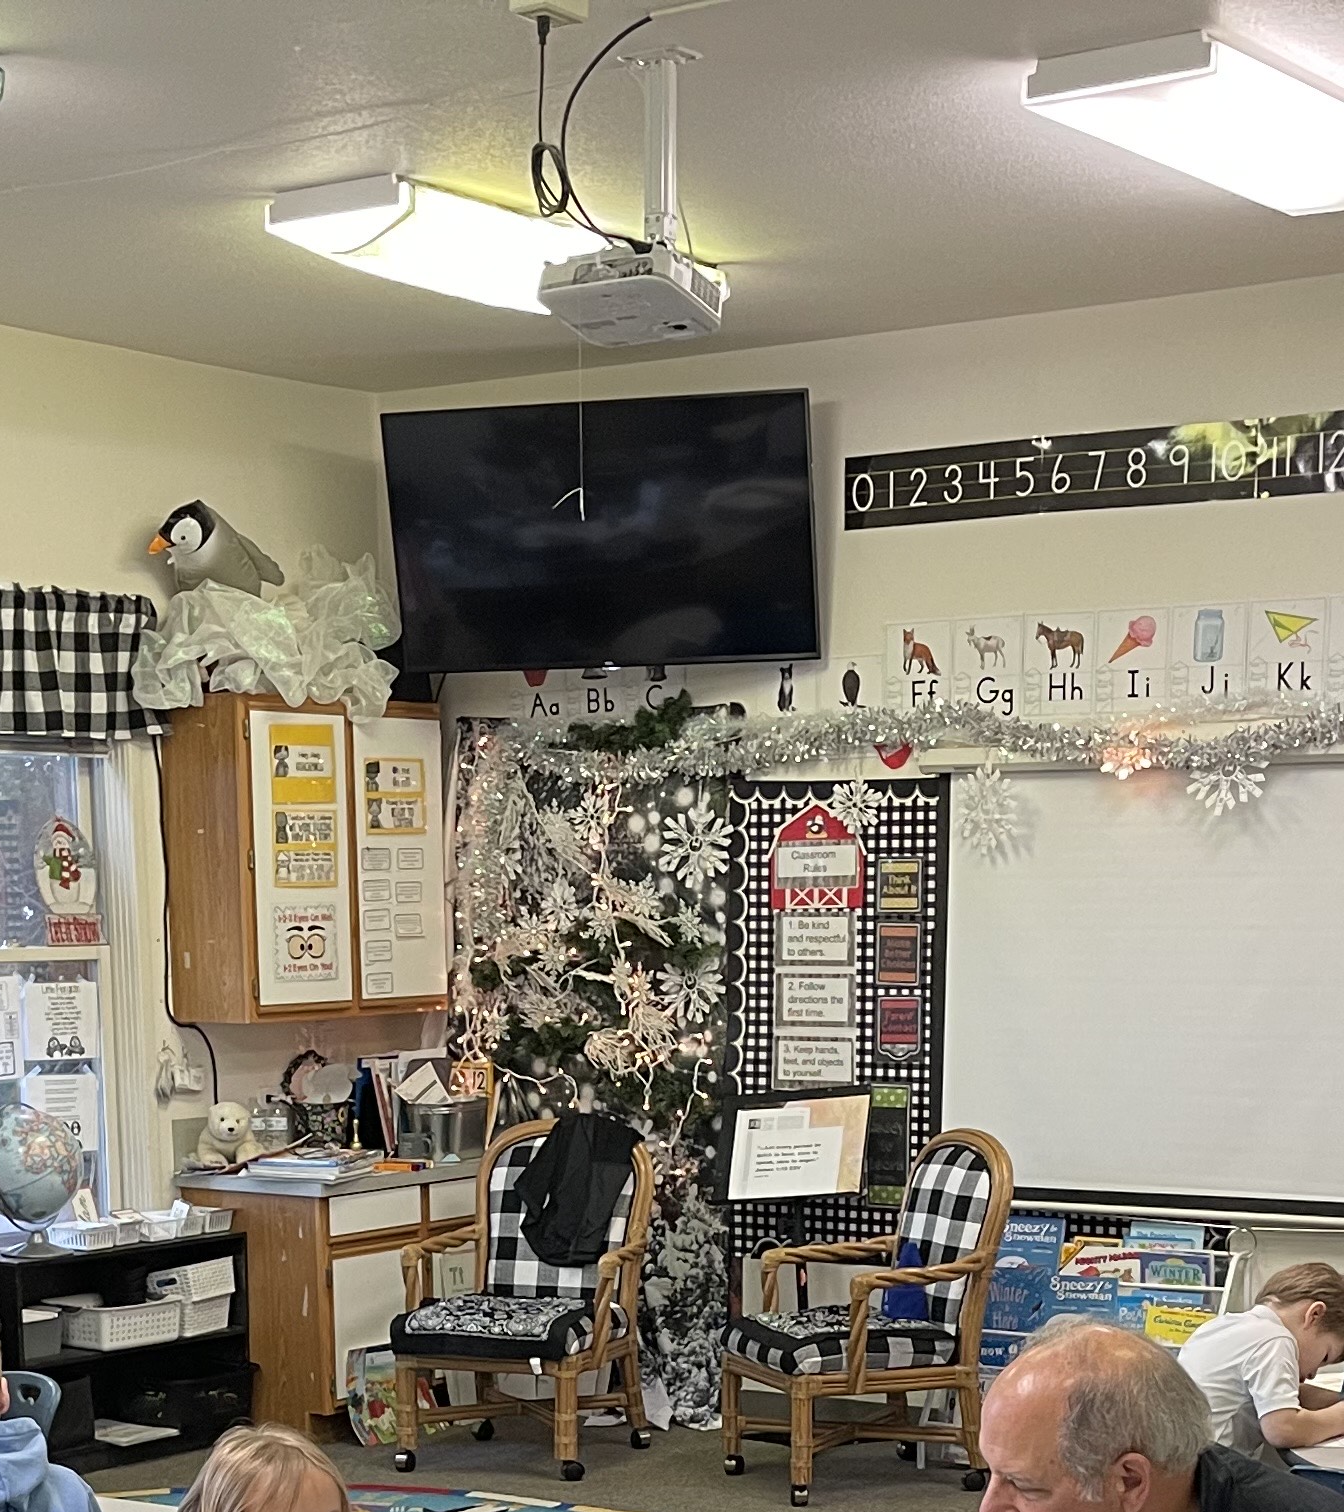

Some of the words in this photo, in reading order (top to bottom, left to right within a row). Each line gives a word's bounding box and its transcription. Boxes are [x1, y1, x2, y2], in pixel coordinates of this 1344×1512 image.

[852, 474, 873, 511] 0
[889, 471, 894, 508] 1
[909, 468, 928, 508] 2
[943, 465, 963, 503] 3
[978, 461, 999, 499] 4
[1016, 457, 1035, 497] 5
[1051, 454, 1071, 494] 6
[1088, 451, 1106, 490] 7
[1126, 448, 1147, 488] 8
[1169, 445, 1189, 484] 9
[1210, 440, 1246, 482] 10
[1271, 436, 1291, 477] 11
[912, 679, 938, 707] Ff
[976, 677, 1014, 716] Gg
[1048, 672, 1084, 700] Hh
[1127, 669, 1151, 698] Ii
[1277, 661, 1312, 691] Kk
[531, 693, 560, 718] Aa
[586, 688, 615, 714] Bb
[791, 850, 836, 860] Classroom
[803, 864, 828, 873] Rules
[798, 920, 810, 929] Be
[812, 920, 830, 930] kind
[787, 934, 804, 942] and
[806, 933, 847, 944] respectful
[787, 948, 796, 956] to
[799, 981, 826, 991] Follow
[788, 995, 829, 1004] directions
[831, 995, 844, 1004] the
[788, 1007, 803, 1017] first
[794, 1045, 814, 1055] Keep
[817, 1058, 844, 1067] objects
[472, 1071, 485, 1090] 12
[1004, 1232, 1056, 1244] Snowman
[1150, 1265, 1201, 1280] WINTER
[1050, 1275, 1104, 1293] Sneezy
[990, 1281, 1030, 1303] Winter
[1056, 1290, 1112, 1301] Snowman
